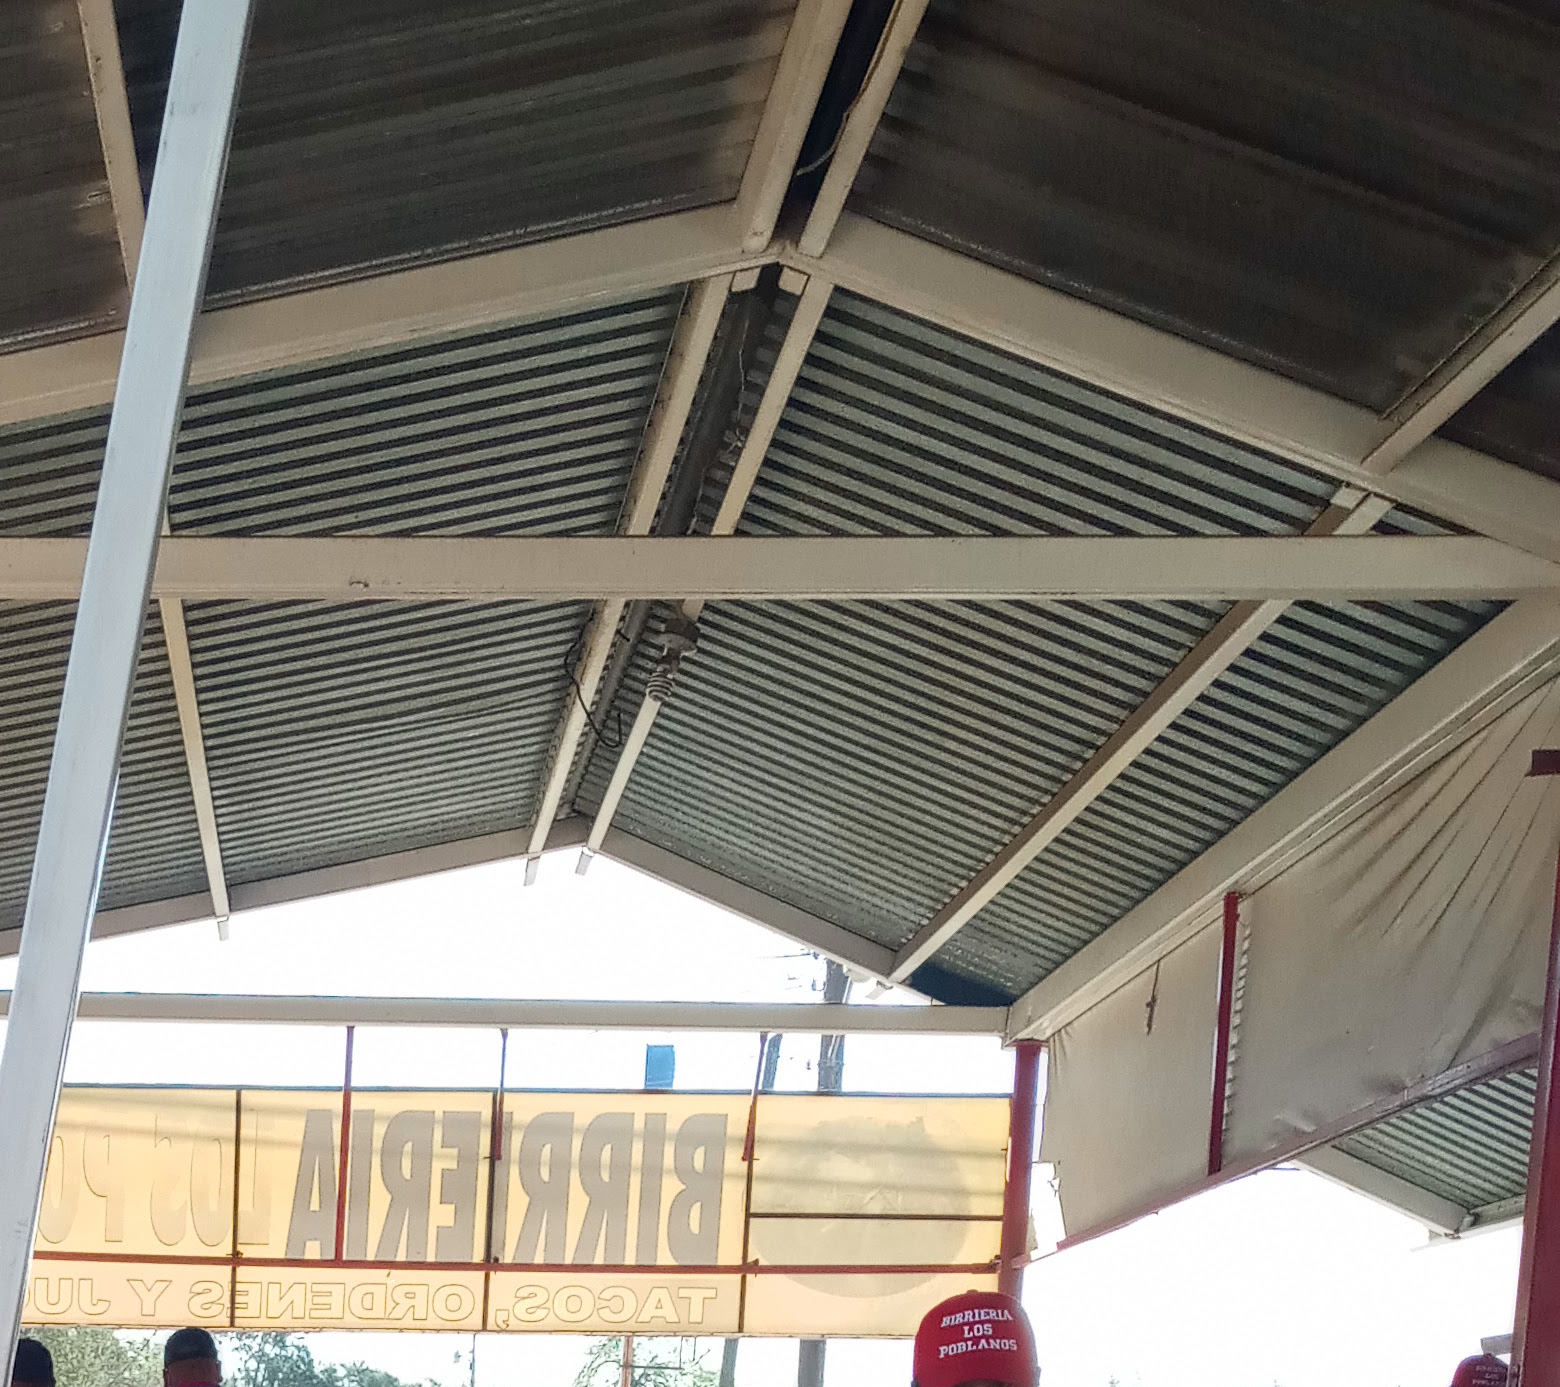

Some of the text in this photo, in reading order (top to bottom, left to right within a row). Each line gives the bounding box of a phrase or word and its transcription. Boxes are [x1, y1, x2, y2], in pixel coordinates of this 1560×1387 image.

[941, 1308, 1013, 1327] BIRRIERIA
[963, 1324, 993, 1338] LOS
[939, 1339, 1017, 1358] POBLANOS
